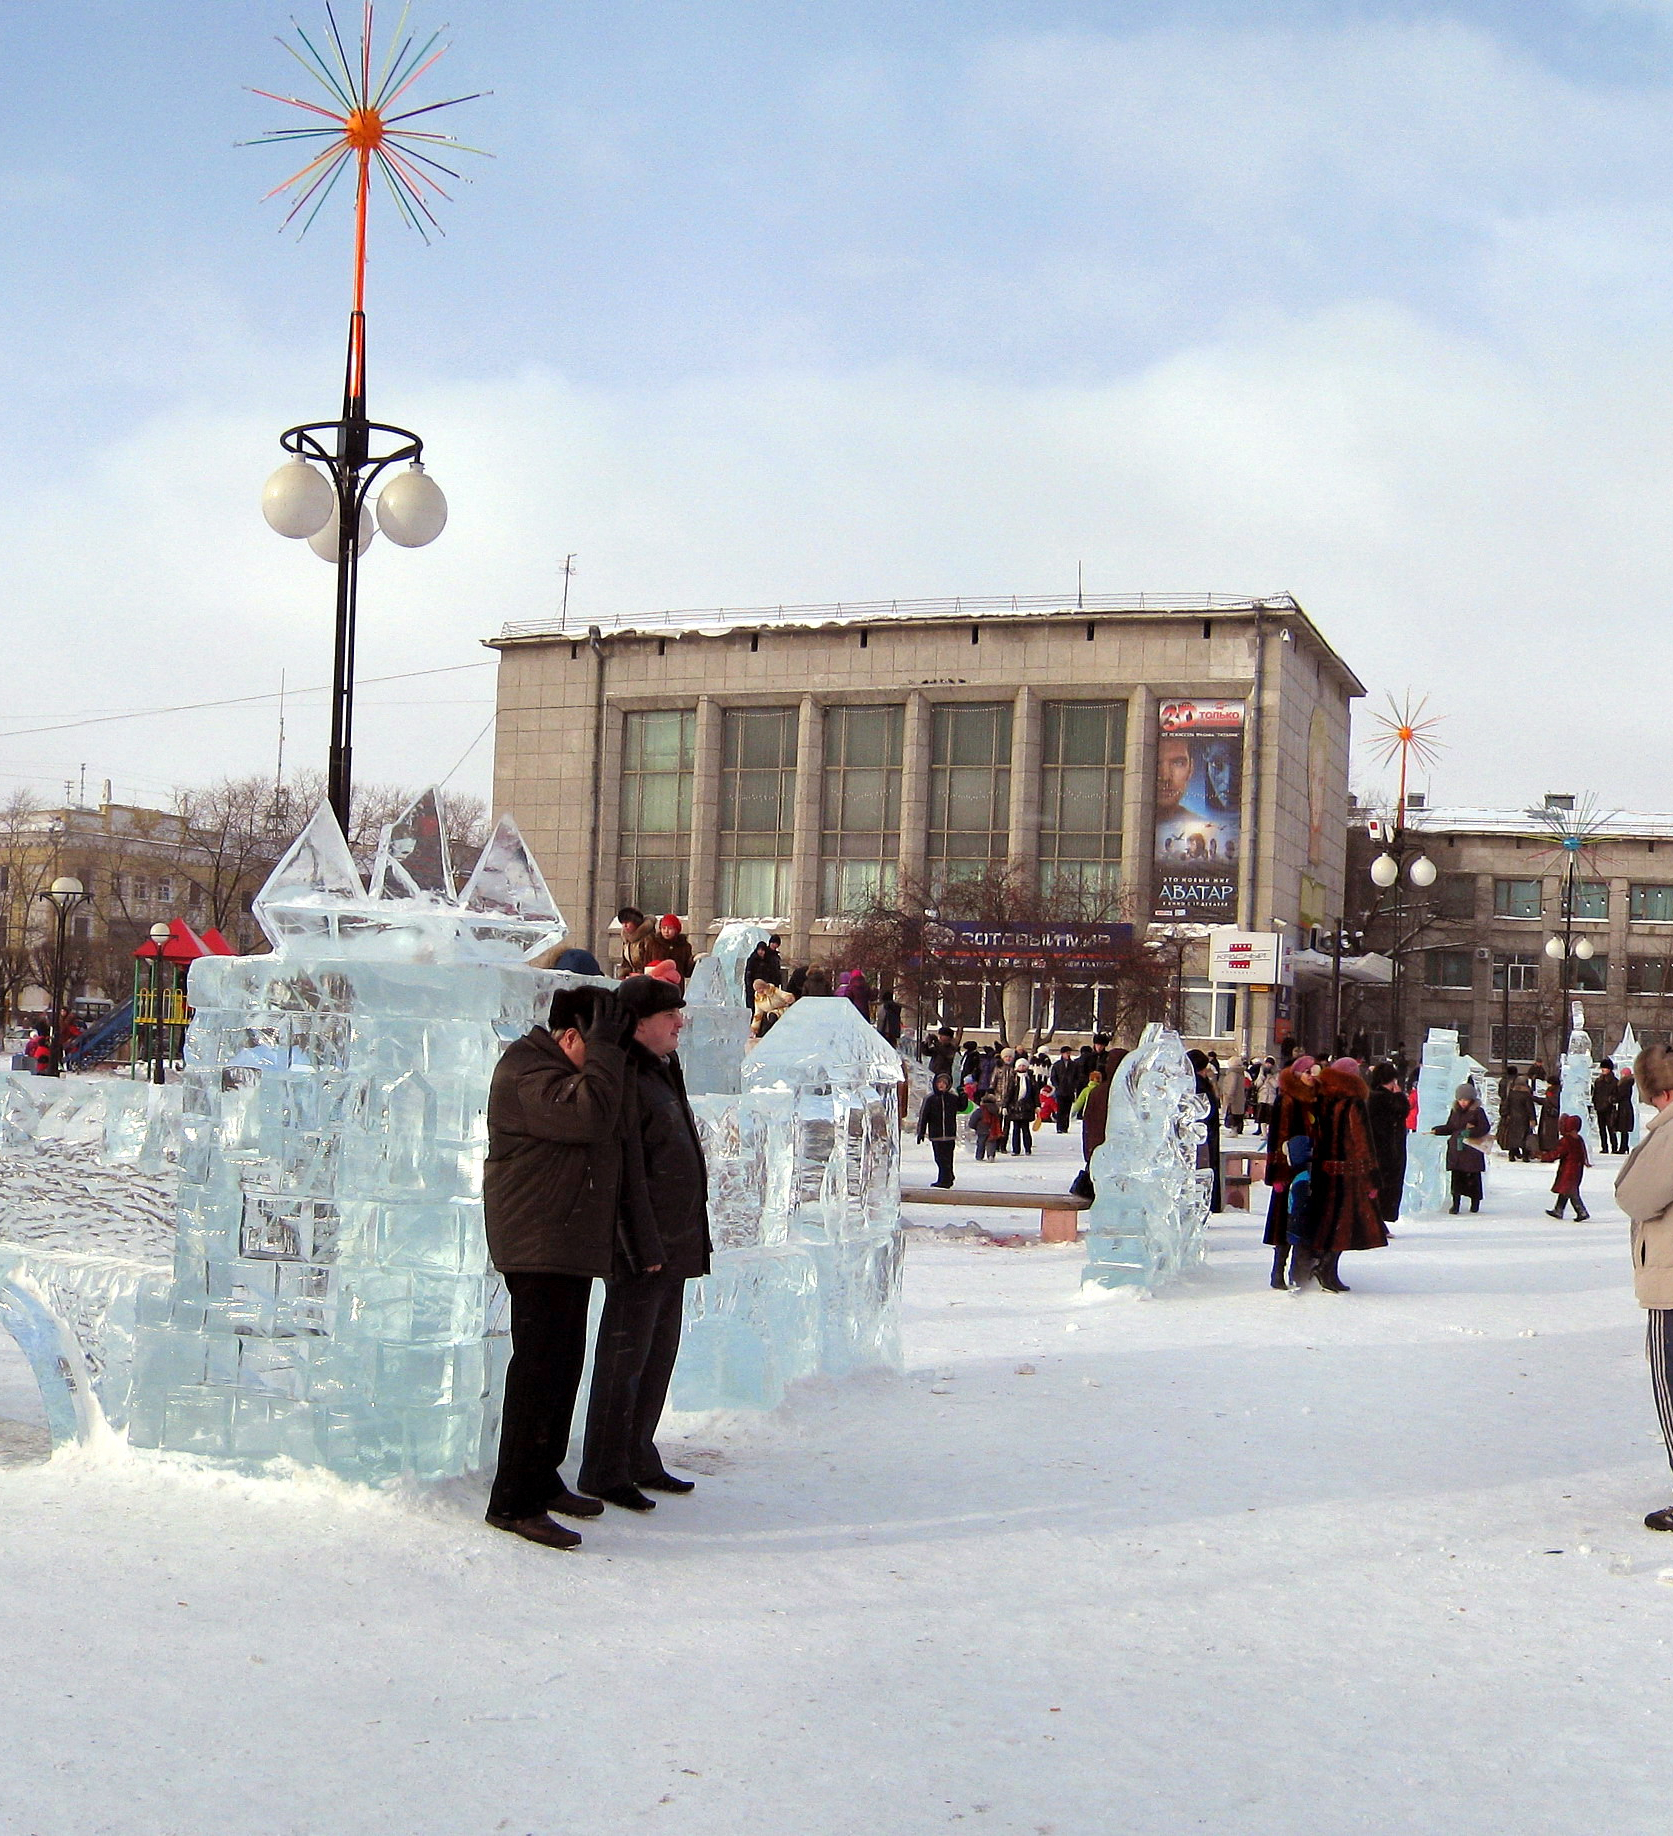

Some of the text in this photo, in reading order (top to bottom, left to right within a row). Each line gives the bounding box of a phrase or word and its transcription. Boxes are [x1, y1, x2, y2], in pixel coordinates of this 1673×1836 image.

[1161, 702, 1240, 732] 3D ТОЛЬКО
[1158, 884, 1234, 901] АВАТАР
